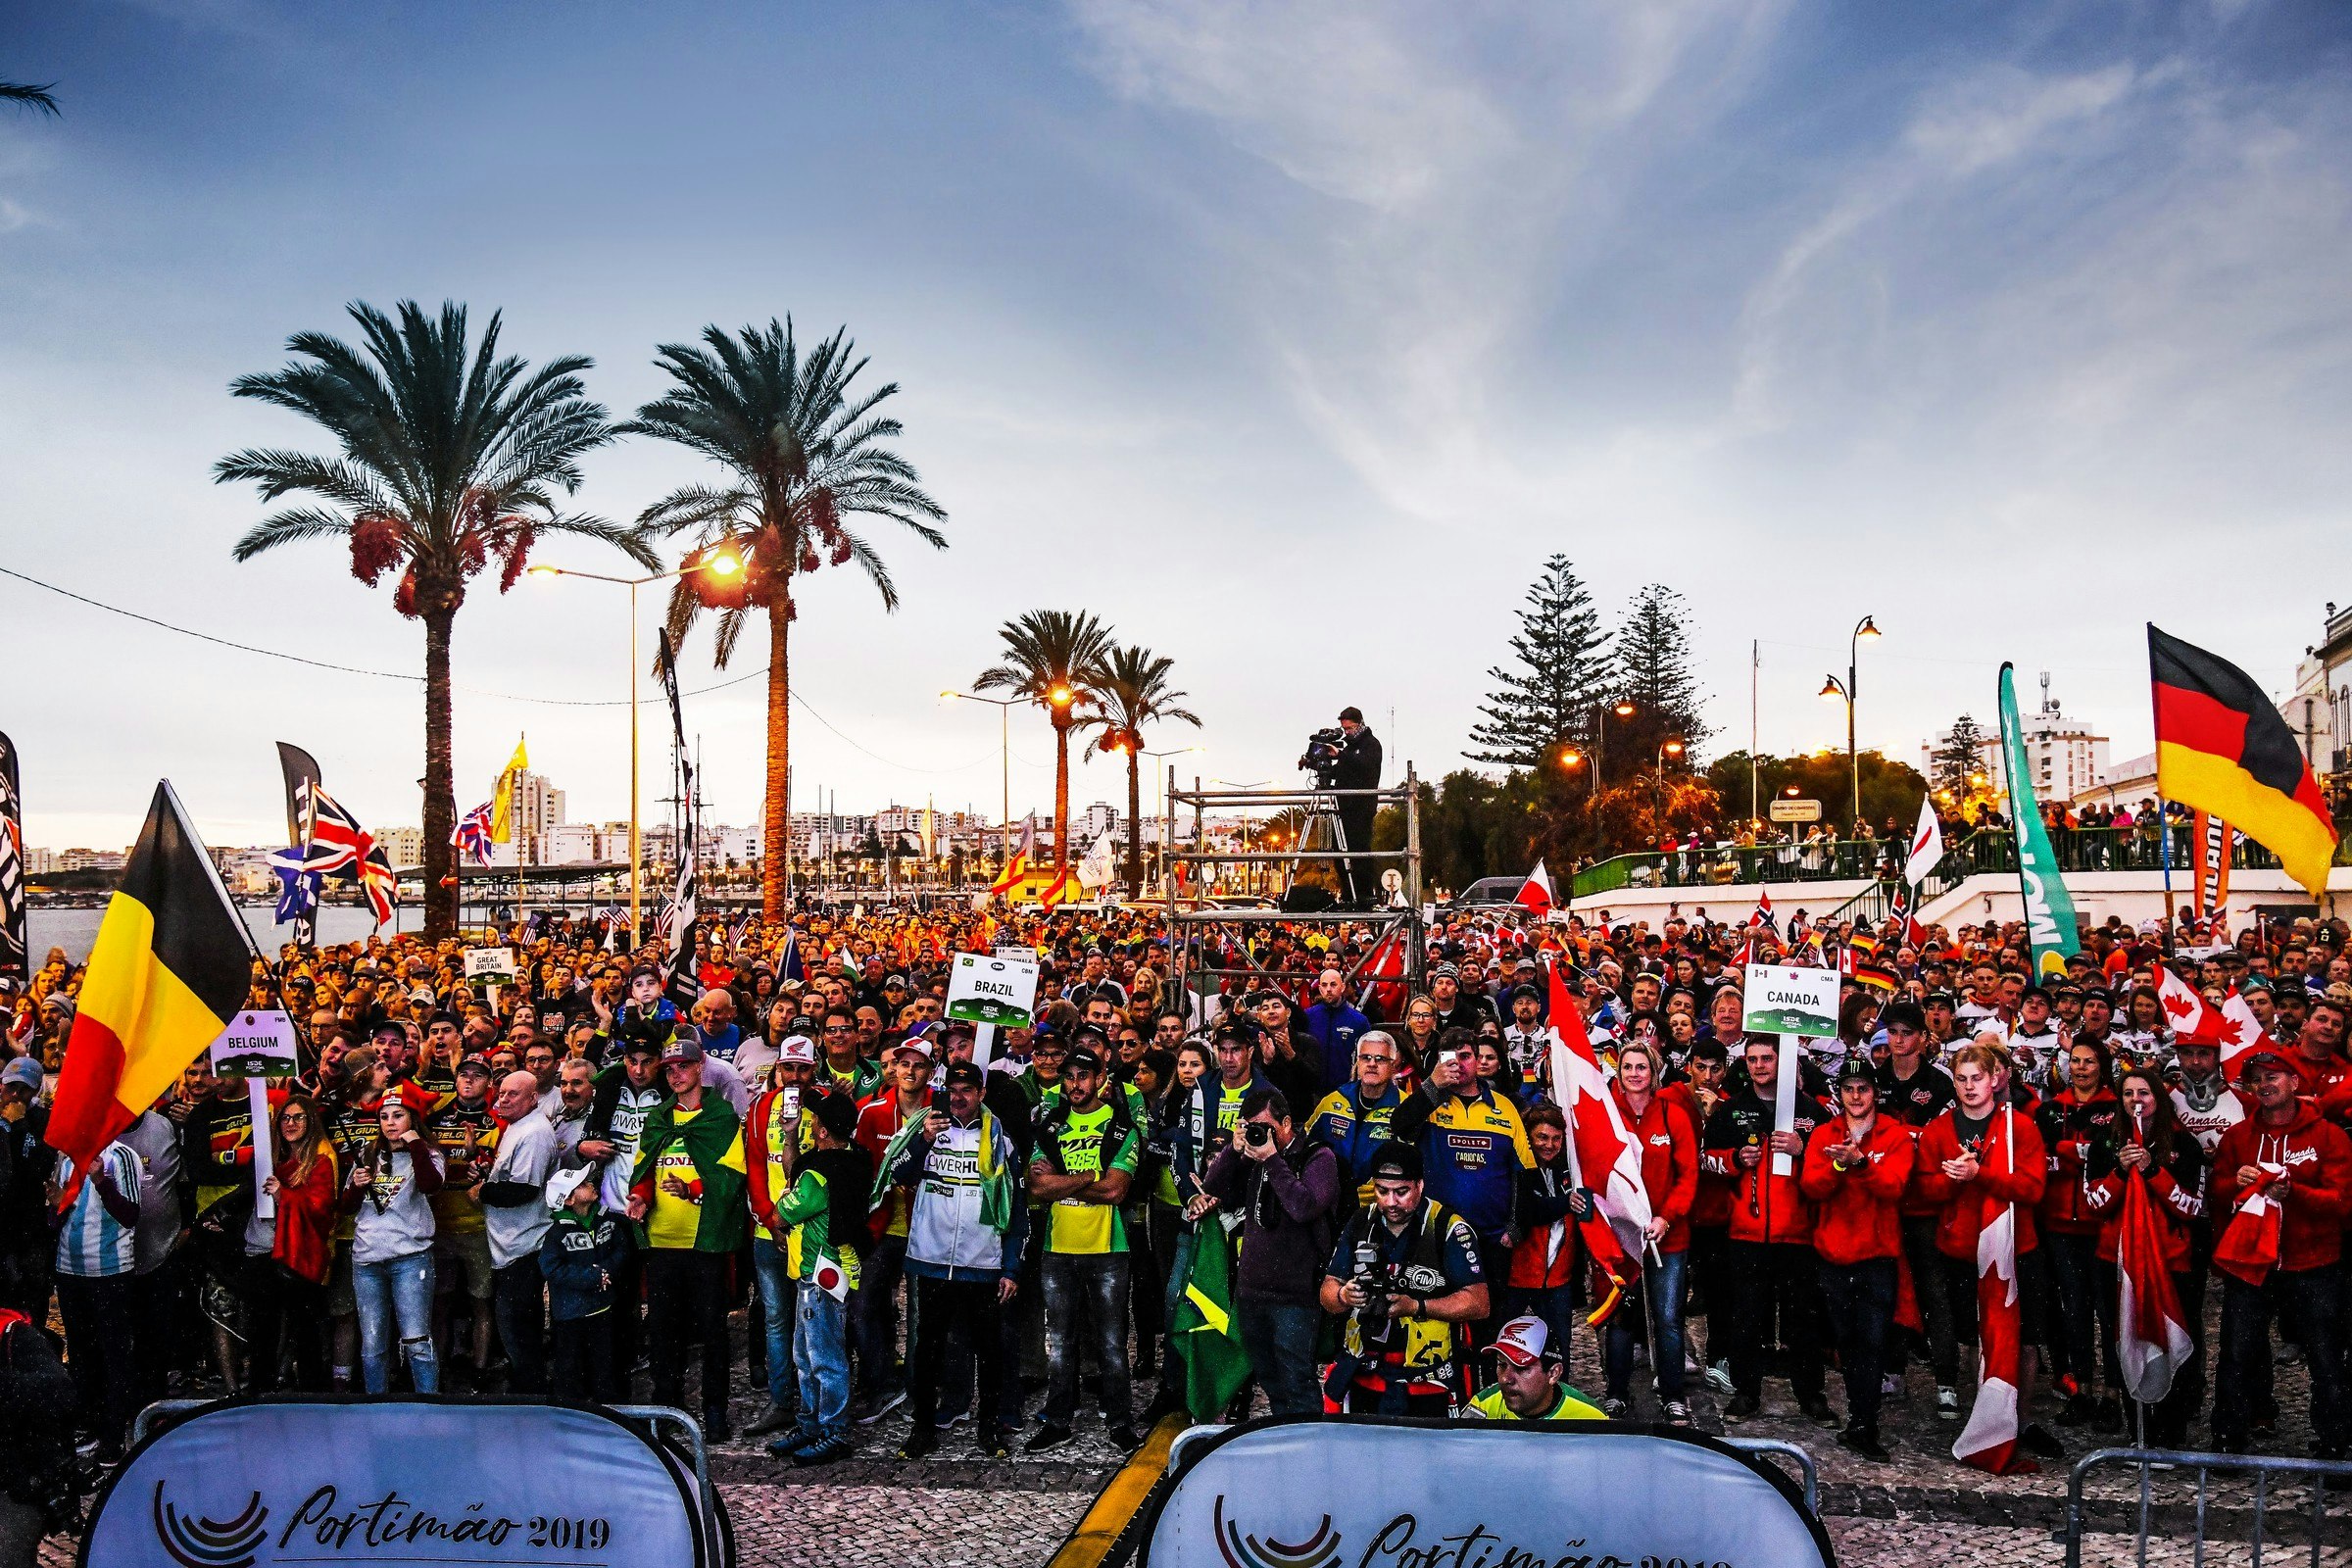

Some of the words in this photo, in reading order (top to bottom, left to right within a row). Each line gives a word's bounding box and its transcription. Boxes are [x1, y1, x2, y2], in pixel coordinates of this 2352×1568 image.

[974, 980, 1014, 997] BRAZIL
[1767, 991, 1820, 1005] CANADA
[227, 1037, 278, 1048] BELGIUM
[2179, 1111, 2230, 1126] Canada
[333, 1127, 379, 1138] BLGIUM
[2284, 1147, 2317, 1161] Canada
[657, 1156, 694, 1166] HON
[1415, 1274, 1434, 1285] FIM
[1500, 1334, 1528, 1347] HONDA
[278, 1484, 522, 1549] Portimão
[527, 1516, 611, 1549] 2019
